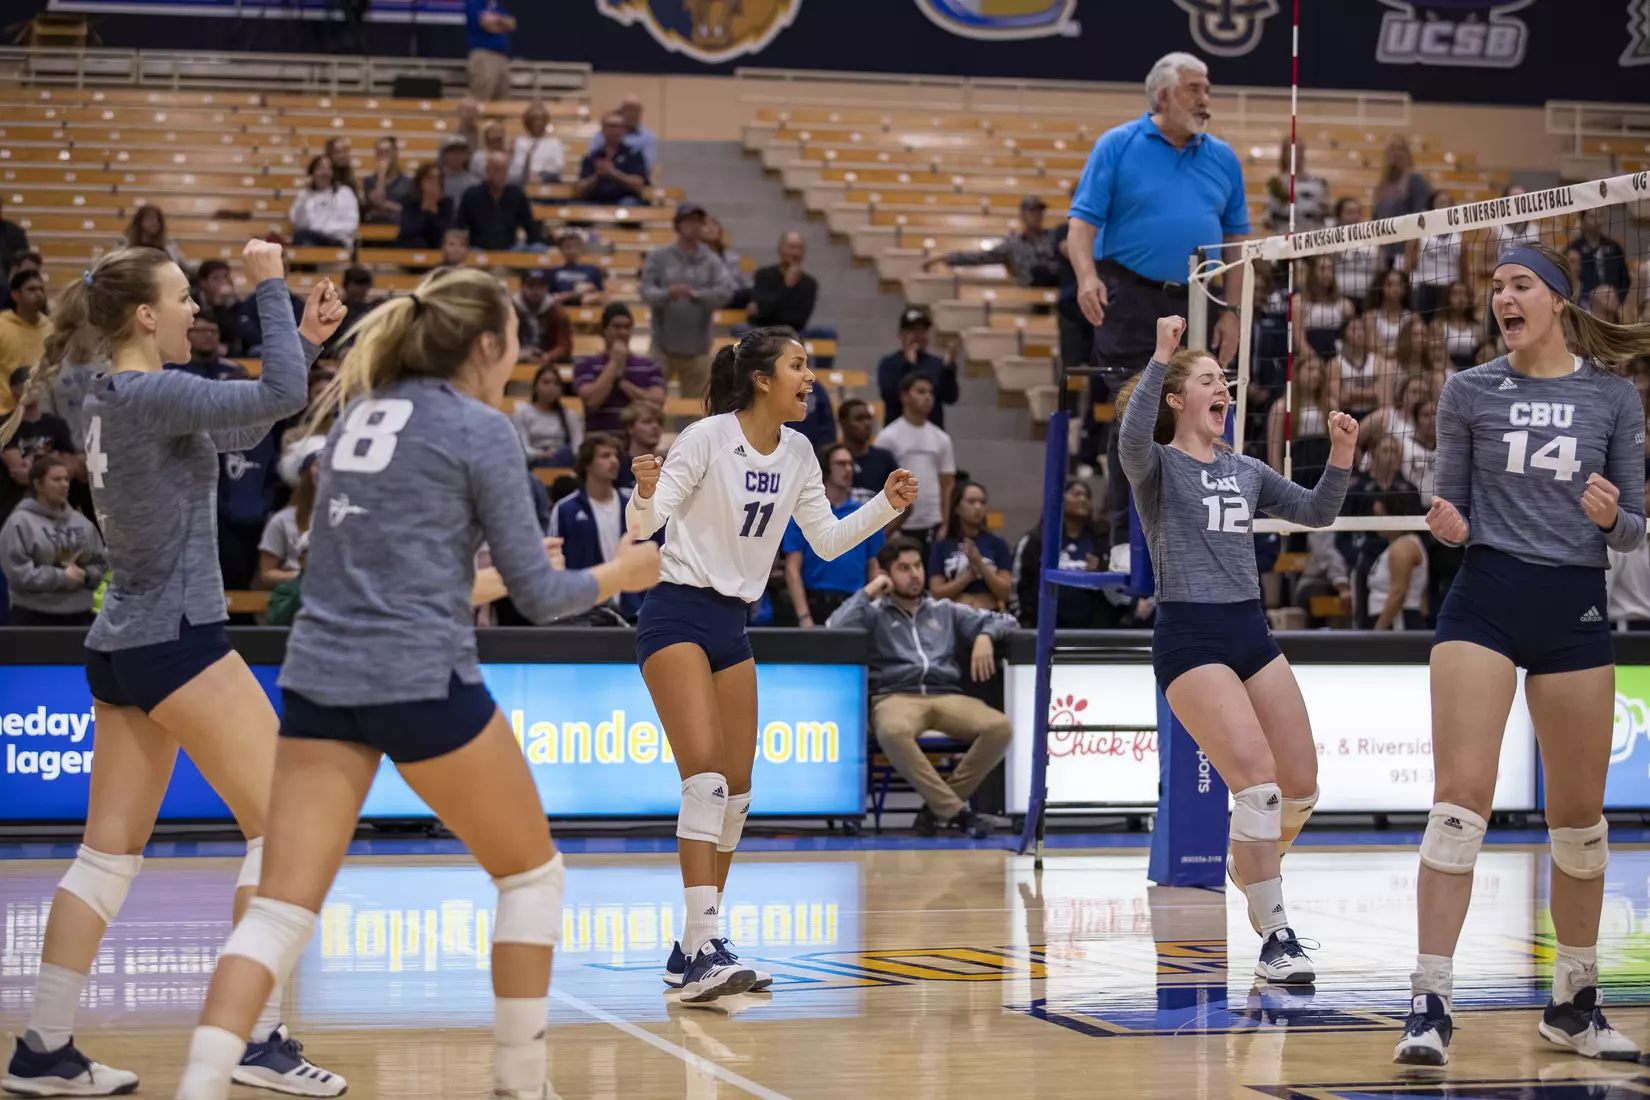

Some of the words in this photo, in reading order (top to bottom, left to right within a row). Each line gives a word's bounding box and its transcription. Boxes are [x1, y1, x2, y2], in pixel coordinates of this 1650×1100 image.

[1383, 18, 1523, 59] UCSB
[1632, 171, 1647, 192] UC
[1447, 208, 1460, 226] UC
[1463, 199, 1511, 223] RIVERSIDE
[1514, 187, 1574, 215] VOLLEYBALL
[1304, 226, 1345, 249] RIVERSIDE
[1347, 218, 1397, 242] VOLLEYBALL
[1509, 401, 1575, 429] CBU
[331, 398, 414, 474] 8
[1502, 430, 1582, 481] 14
[745, 470, 781, 494] CBU
[739, 501, 775, 537] 11
[1202, 495, 1250, 534] 12
[0, 705, 96, 743] eday'
[1047, 710, 1159, 762] Chick-fi
[7, 743, 94, 781] lager
[1338, 738, 1350, 756] &
[1358, 738, 1432, 756] Riversid
[1195, 748, 1211, 794] ports
[1390, 768, 1434, 783] 951-3
